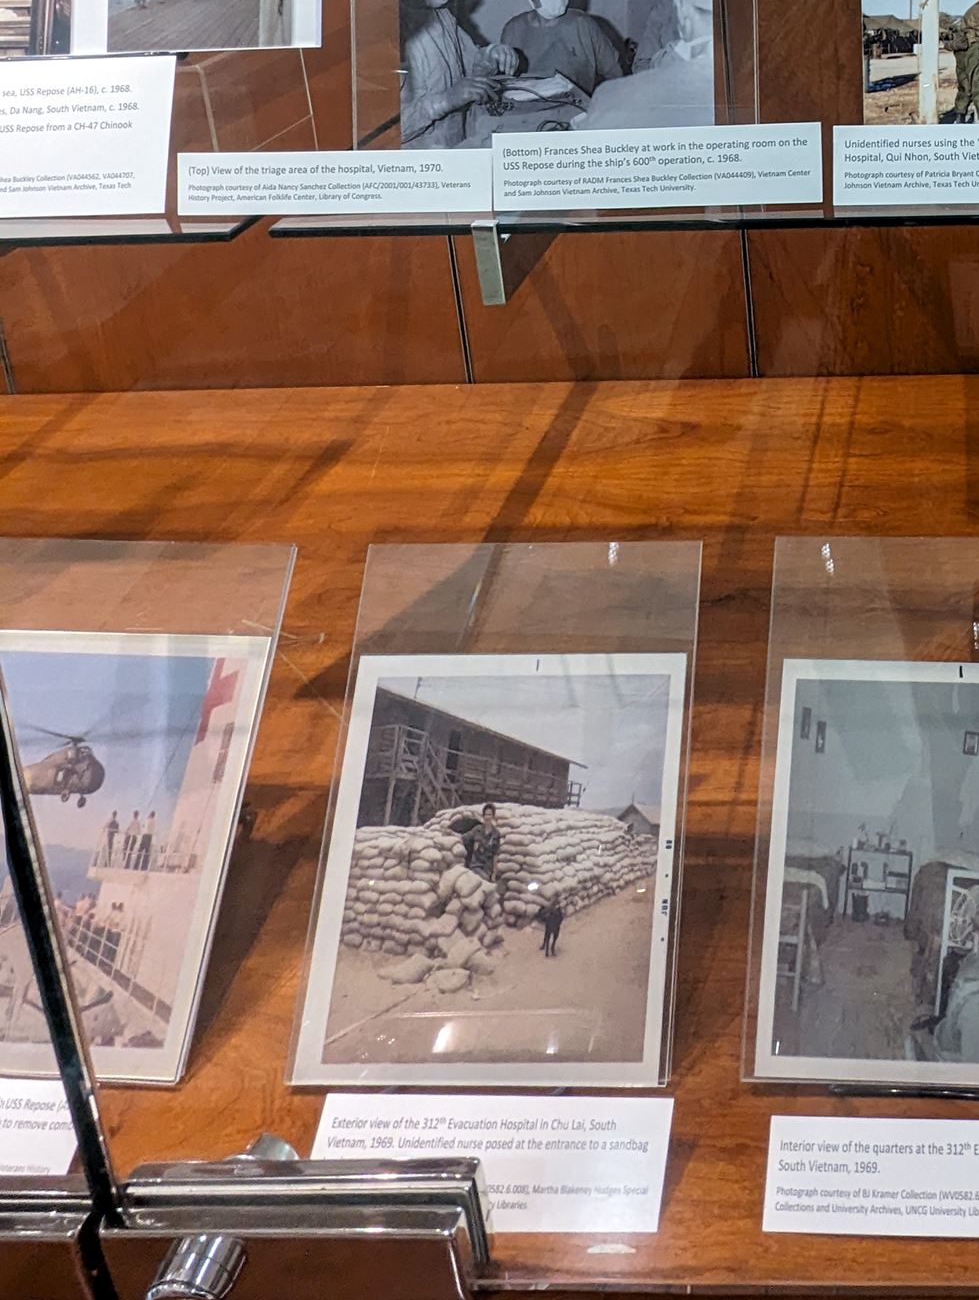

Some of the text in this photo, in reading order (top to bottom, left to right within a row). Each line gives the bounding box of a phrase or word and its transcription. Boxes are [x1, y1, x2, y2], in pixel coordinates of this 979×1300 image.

[19, 88, 34, 96] USS
[36, 87, 65, 98] Repose
[9, 107, 20, 115] Da
[46, 104, 69, 114] South
[15, 123, 44, 134] Repose
[45, 122, 65, 131] from
[73, 122, 98, 130] CH-47
[99, 120, 132, 130] Chinook
[502, 146, 542, 158] (Bottom)
[543, 145, 578, 155] Frances
[580, 144, 602, 154] Shea
[604, 143, 640, 155] Buckley
[640, 143, 650, 152] at
[652, 142, 676, 151] work
[677, 142, 686, 151] in
[688, 141, 704, 150] the
[705, 140, 750, 152] operating
[792, 138, 808, 147] the
[844, 139, 900, 149] Unidentified
[933, 139, 958, 150] using
[959, 138, 975, 147] the
[503, 162, 520, 171] USS
[521, 161, 554, 172] Repose
[556, 159, 585, 171] during
[587, 158, 603, 168] the
[657, 155, 705, 167] operation,
[717, 154, 742, 163] 1968.
[844, 153, 884, 164] Hospital,
[885, 153, 902, 164] Qui
[904, 152, 931, 163] Nhon,
[933, 152, 960, 161] South
[188, 166, 210, 177] (Top)
[211, 166, 232, 175] View
[233, 165, 243, 175] of
[244, 165, 259, 174] the
[261, 166, 286, 176] triage
[309, 165, 319, 174] of
[320, 164, 336, 174] the
[337, 164, 375, 175] hospital,
[377, 164, 417, 174] Vietnam,
[419, 164, 444, 172] 1970.
[844, 181, 872, 189] Johnson
[953, 180, 970, 188] Tech
[331, 1117, 368, 1129] Exterior
[368, 1118, 391, 1129] view
[391, 1117, 403, 1129] of
[402, 1117, 420, 1129] the
[446, 1118, 498, 1130] Evacuation
[498, 1118, 538, 1133] Hospital
[538, 1119, 549, 1130] in
[549, 1118, 569, 1130] Chu
[588, 1119, 617, 1131] South
[780, 1140, 815, 1152] Interior
[816, 1141, 839, 1153] view
[841, 1140, 852, 1153] of
[853, 1140, 870, 1153] the
[871, 1142, 913, 1157] quarters
[915, 1143, 925, 1154] at
[927, 1142, 944, 1155] the
